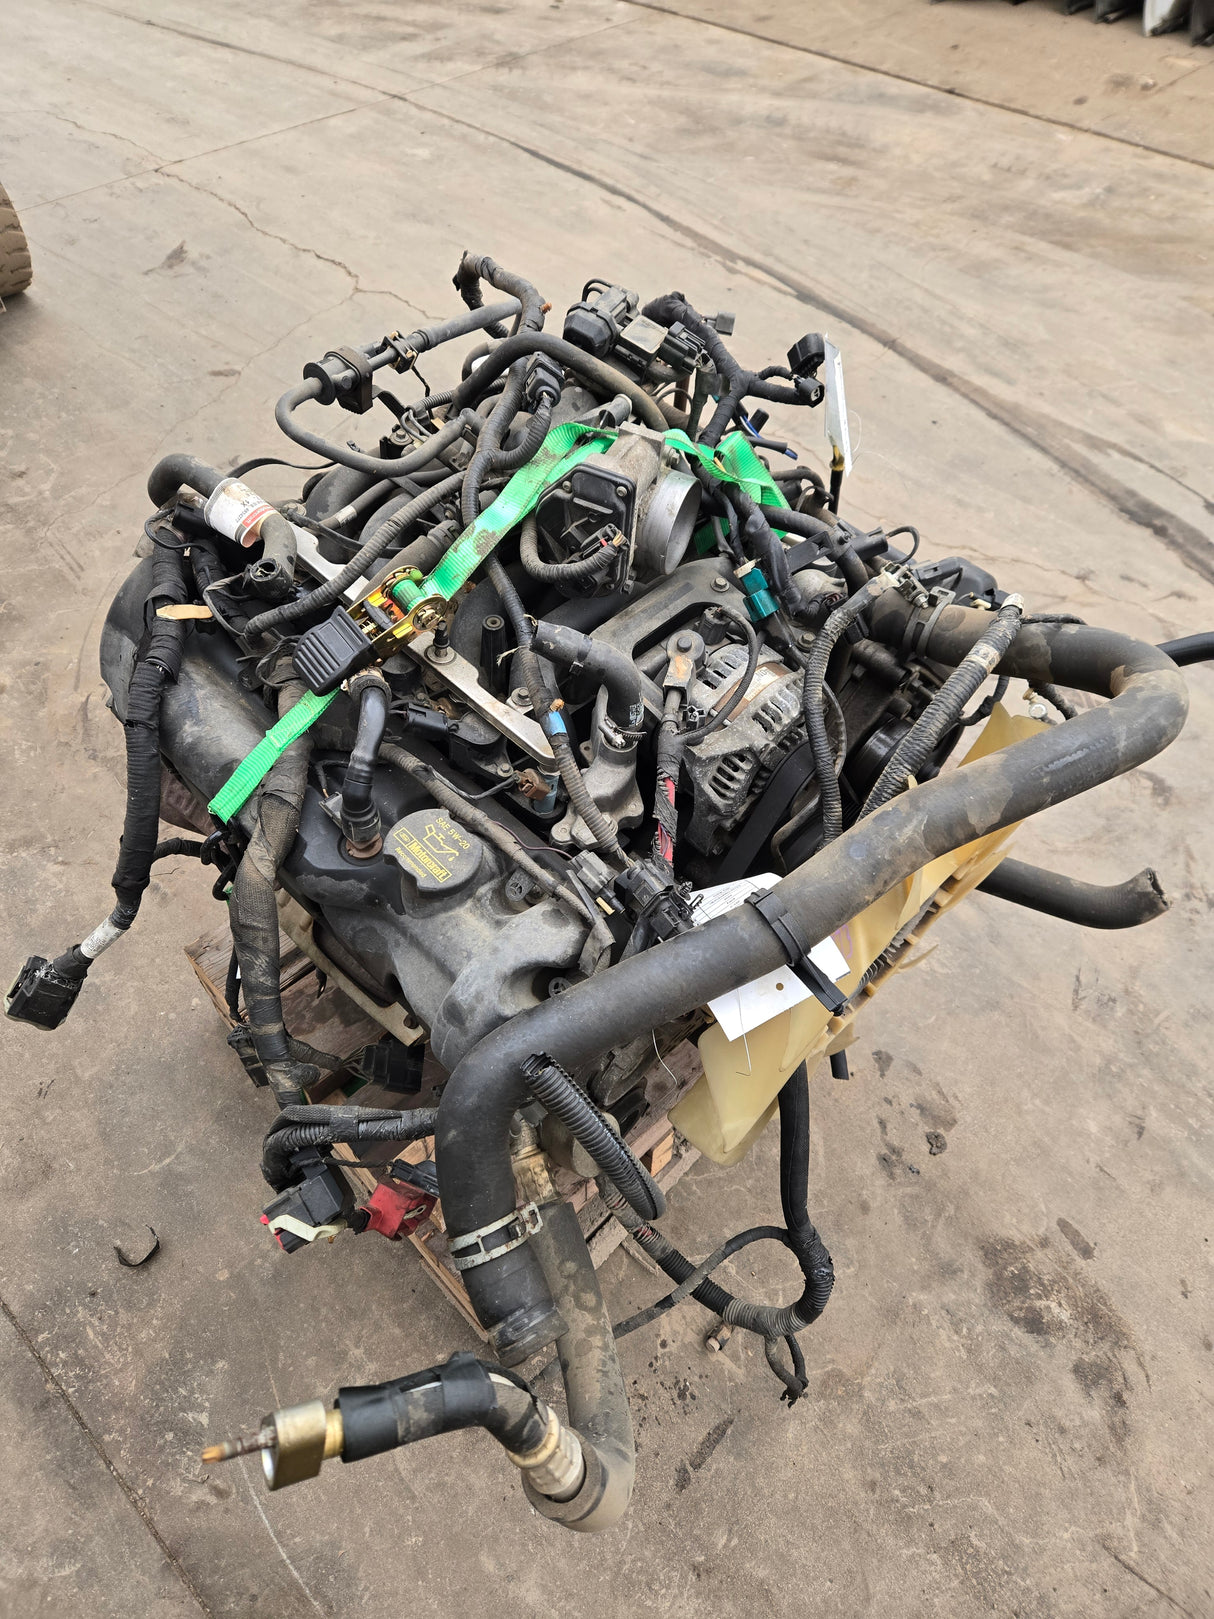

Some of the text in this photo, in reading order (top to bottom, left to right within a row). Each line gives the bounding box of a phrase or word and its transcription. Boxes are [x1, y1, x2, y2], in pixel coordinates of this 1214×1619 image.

[435, 817, 470, 850] SAE 5W-20
[408, 840, 448, 881] Motorcraft
